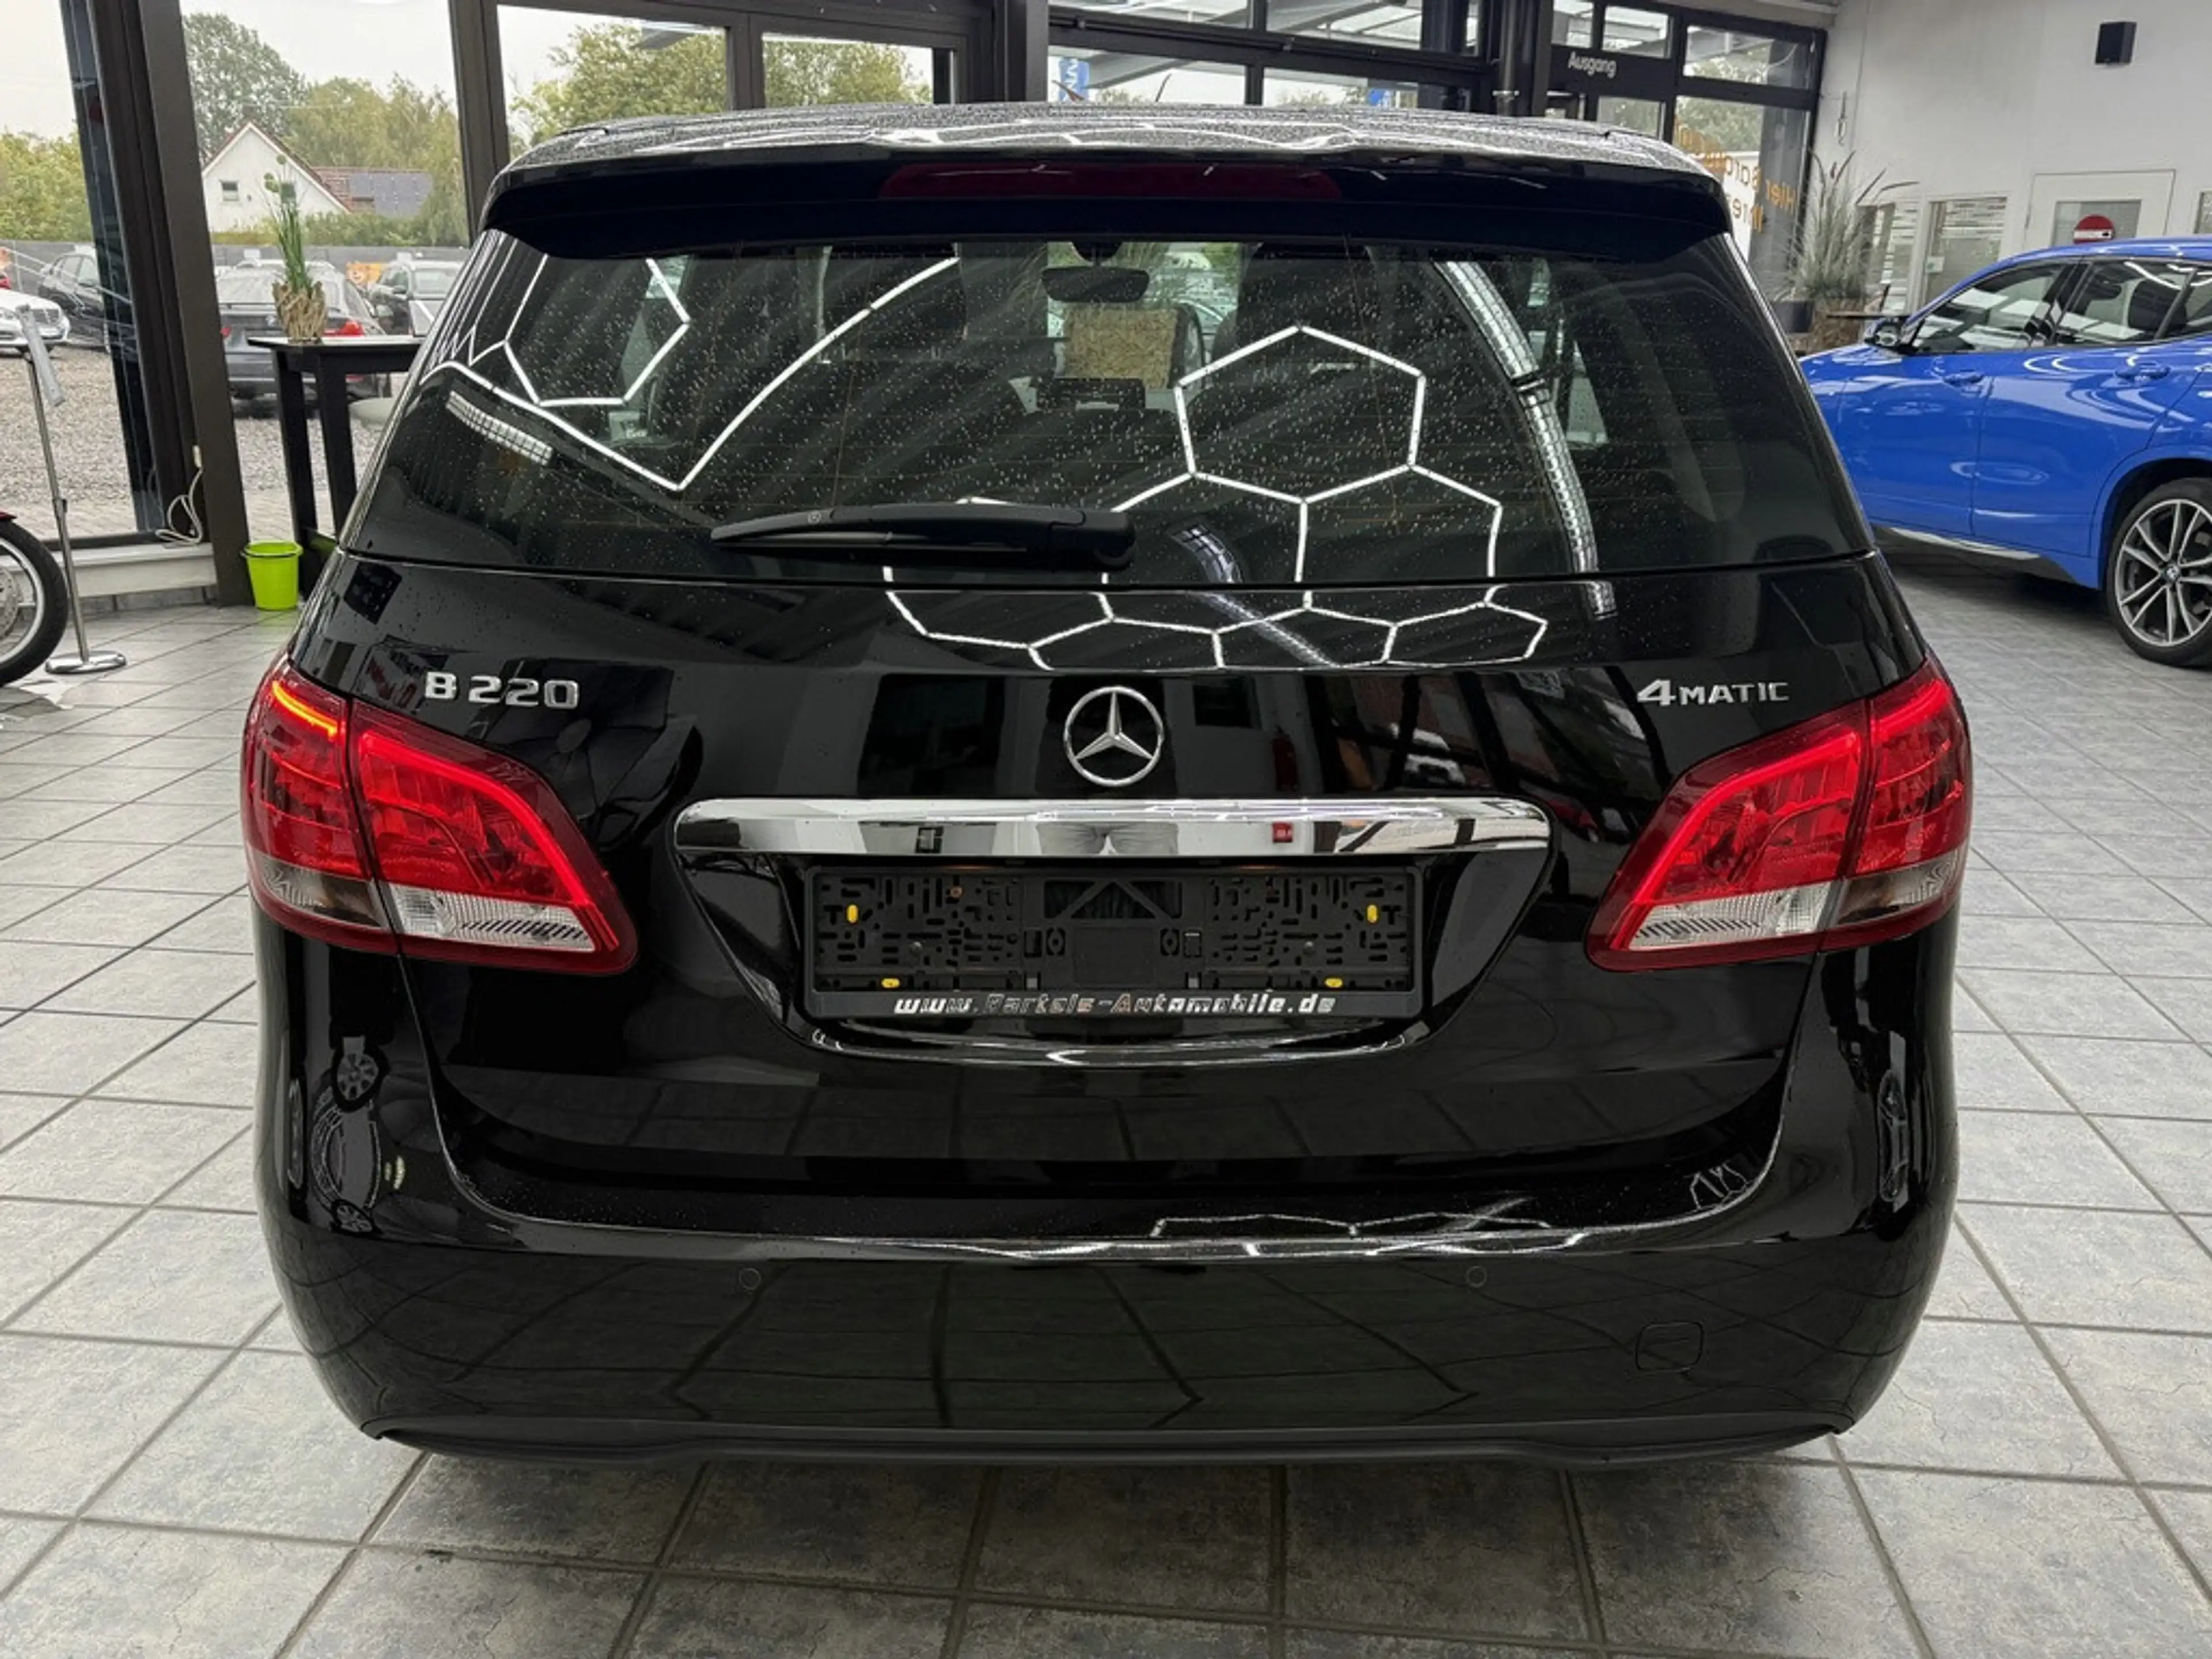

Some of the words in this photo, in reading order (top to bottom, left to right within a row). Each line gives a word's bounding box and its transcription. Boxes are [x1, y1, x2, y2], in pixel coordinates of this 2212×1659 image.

[1568, 51, 1617, 79] Ausgang
[425, 672, 457, 699] B
[468, 675, 578, 709] 220
[1637, 679, 1789, 706] 4MATIC
